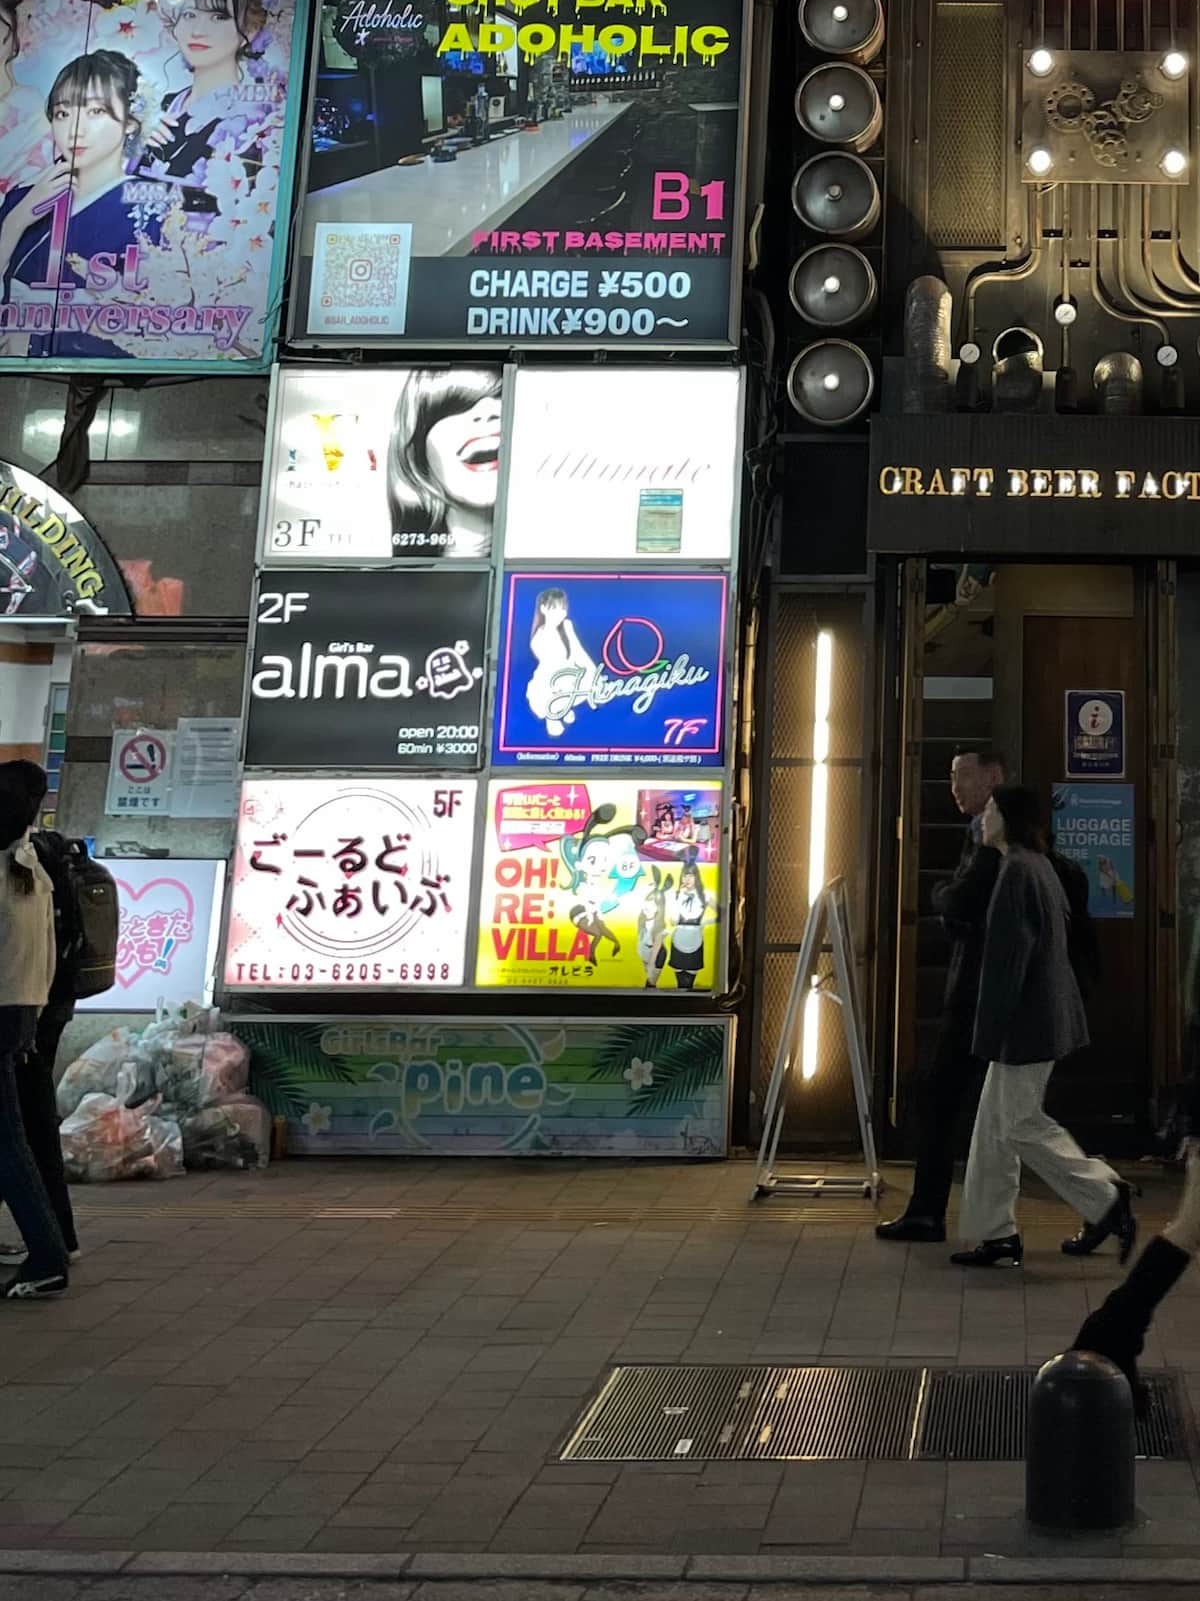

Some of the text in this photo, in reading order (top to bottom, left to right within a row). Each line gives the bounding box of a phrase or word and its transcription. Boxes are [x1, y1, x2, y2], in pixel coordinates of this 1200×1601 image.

[340, 0, 423, 34] Adoholic
[436, 23, 731, 69] ADOHOLIC
[652, 171, 727, 222] B1
[29, 186, 149, 292] 1st
[472, 231, 726, 256] FIRST BASEMENT
[469, 269, 692, 300] CHARGE ¥500
[879, 466, 994, 497] CRAFT
[1006, 468, 1102, 499] BEER
[257, 592, 310, 623] 2F
[252, 642, 413, 699] alma
[398, 725, 479, 739] open 20:00
[398, 744, 478, 754] 60min ¥3000
[434, 790, 463, 818] 5F
[1056, 817, 1132, 832] LUGGAGE
[1056, 832, 1132, 847] STORAGE
[250, 833, 412, 879] ごーるど
[495, 858, 559, 889] OH!
[286, 875, 451, 918] ふぁいぶ
[491, 928, 592, 962] VILLA
[402, 1058, 548, 1119] pine
